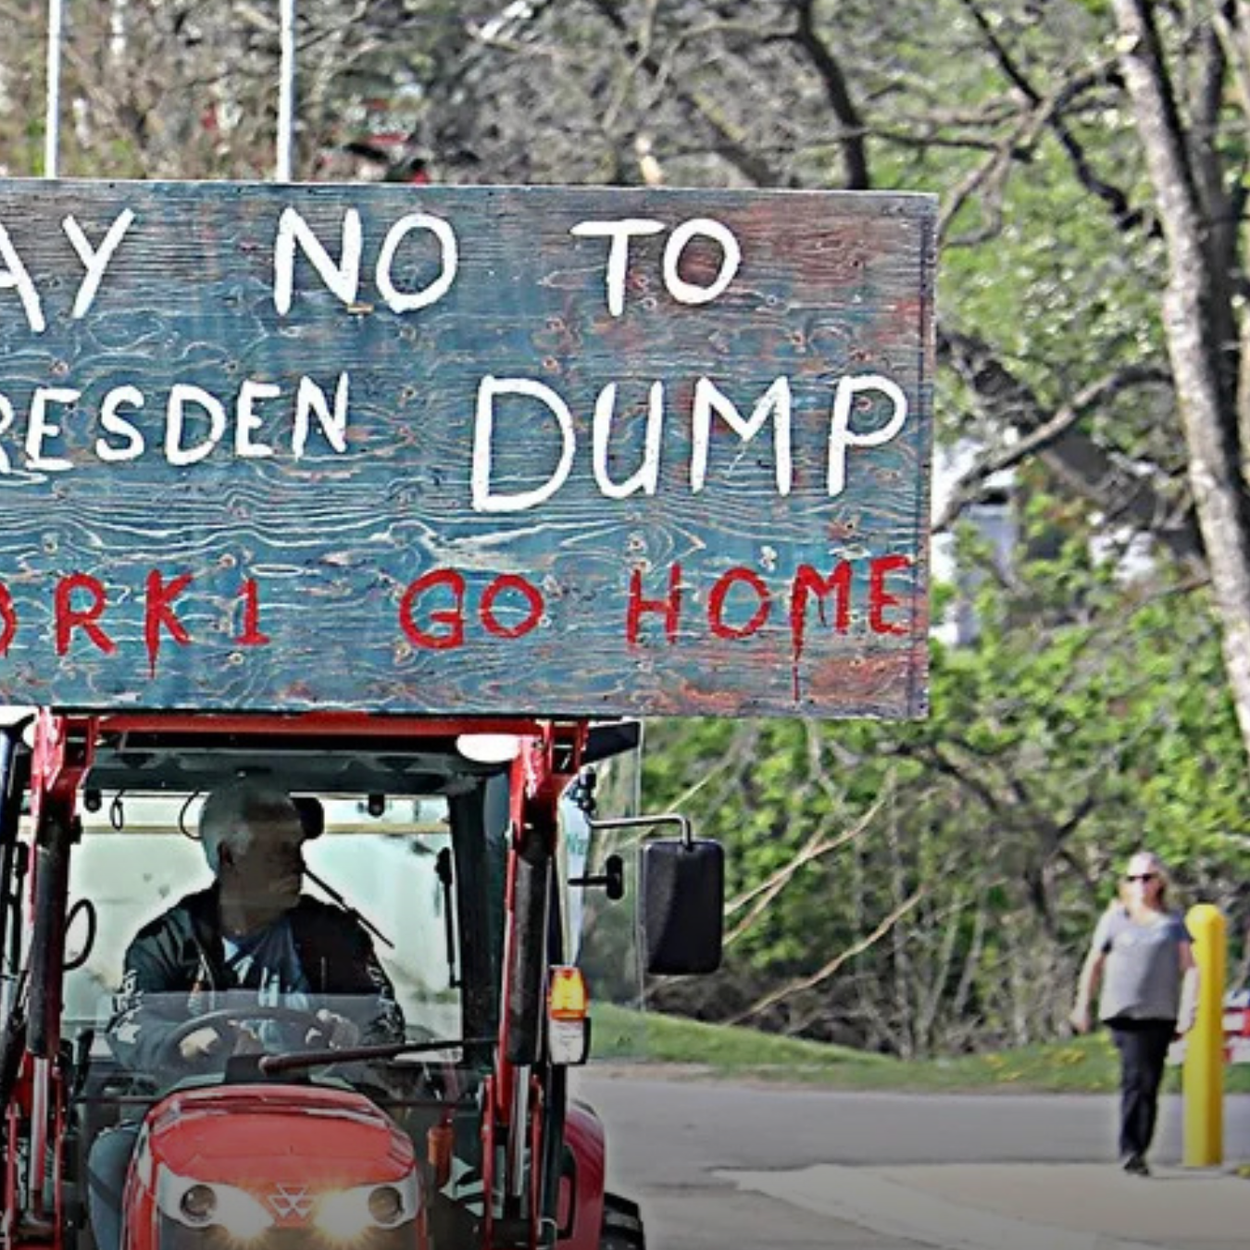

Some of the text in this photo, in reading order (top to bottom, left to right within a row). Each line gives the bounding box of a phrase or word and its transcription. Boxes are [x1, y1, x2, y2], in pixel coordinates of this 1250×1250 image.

[273, 206, 458, 315] NO
[570, 218, 741, 316] TO
[471, 374, 908, 513] DUMP
[399, 568, 545, 649] GO
[626, 555, 914, 660] HOME
